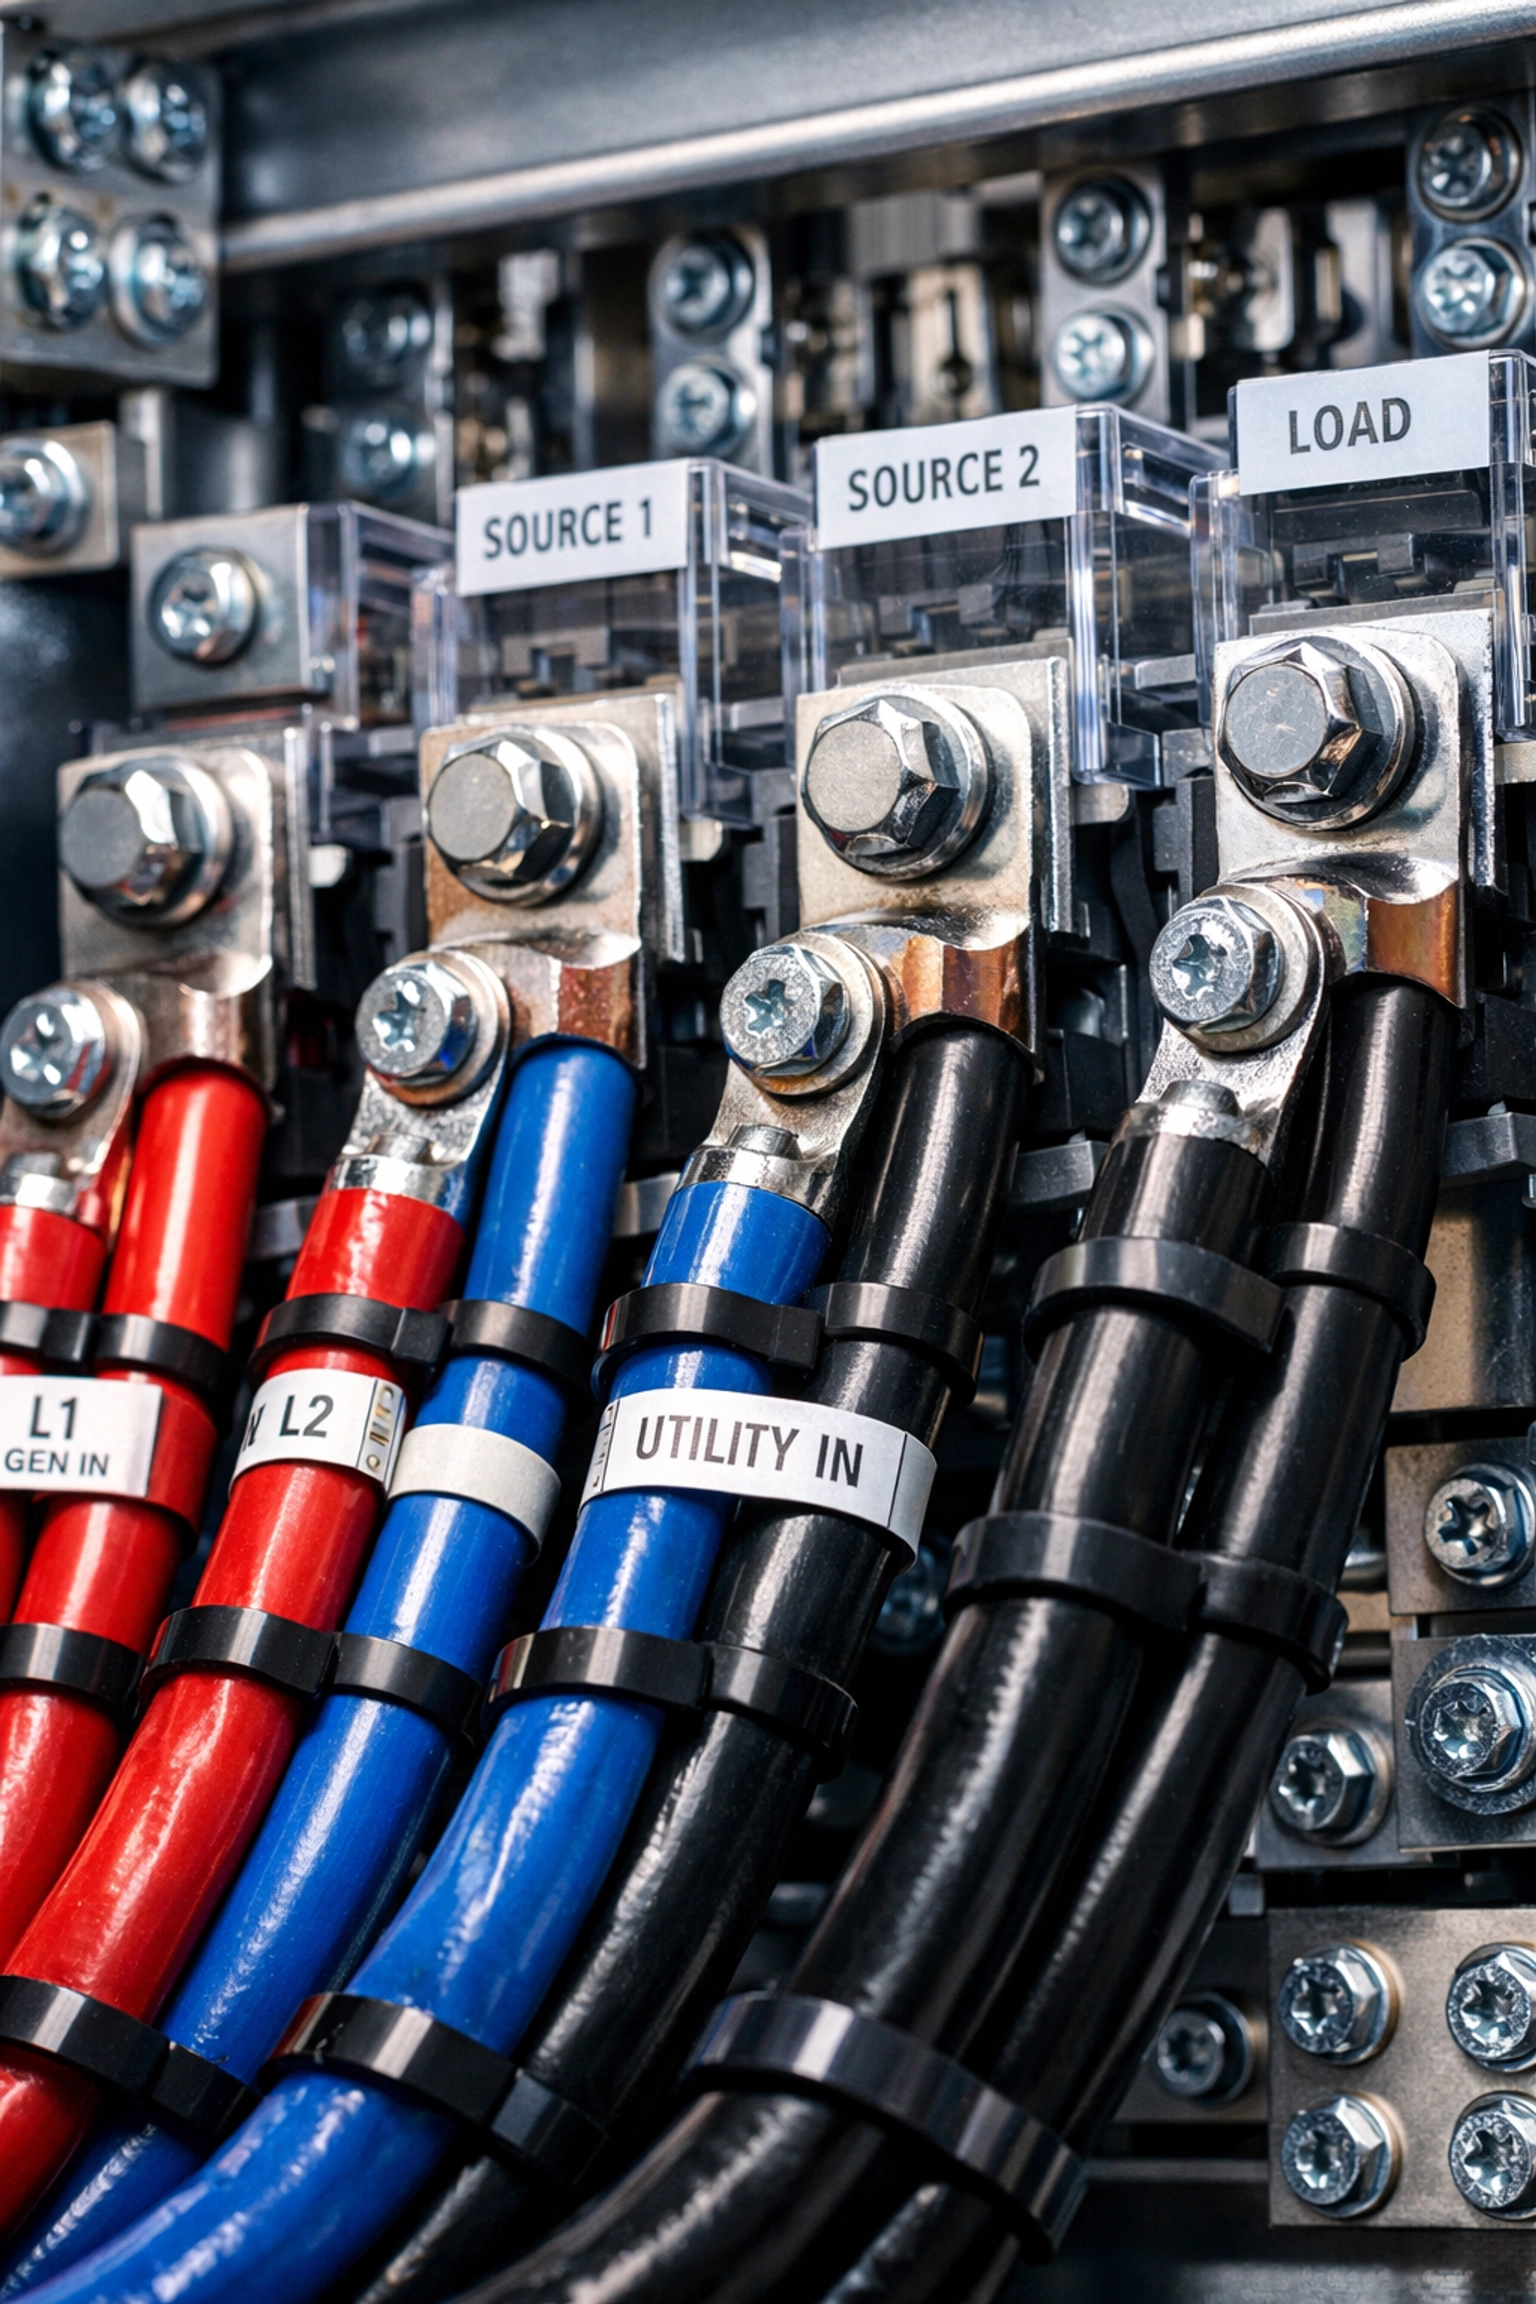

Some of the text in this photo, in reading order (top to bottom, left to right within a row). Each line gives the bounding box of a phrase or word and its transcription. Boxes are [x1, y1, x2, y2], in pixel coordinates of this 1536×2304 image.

[1288, 397, 1412, 455] LOAD
[848, 444, 1040, 512] SOURCE 2
[484, 498, 652, 560] SOURCE 1
[29, 1395, 79, 1440] L1
[279, 1394, 334, 1438] L2
[4, 1448, 109, 1477] GEN IN
[636, 1415, 864, 1488] UTILITY IN
